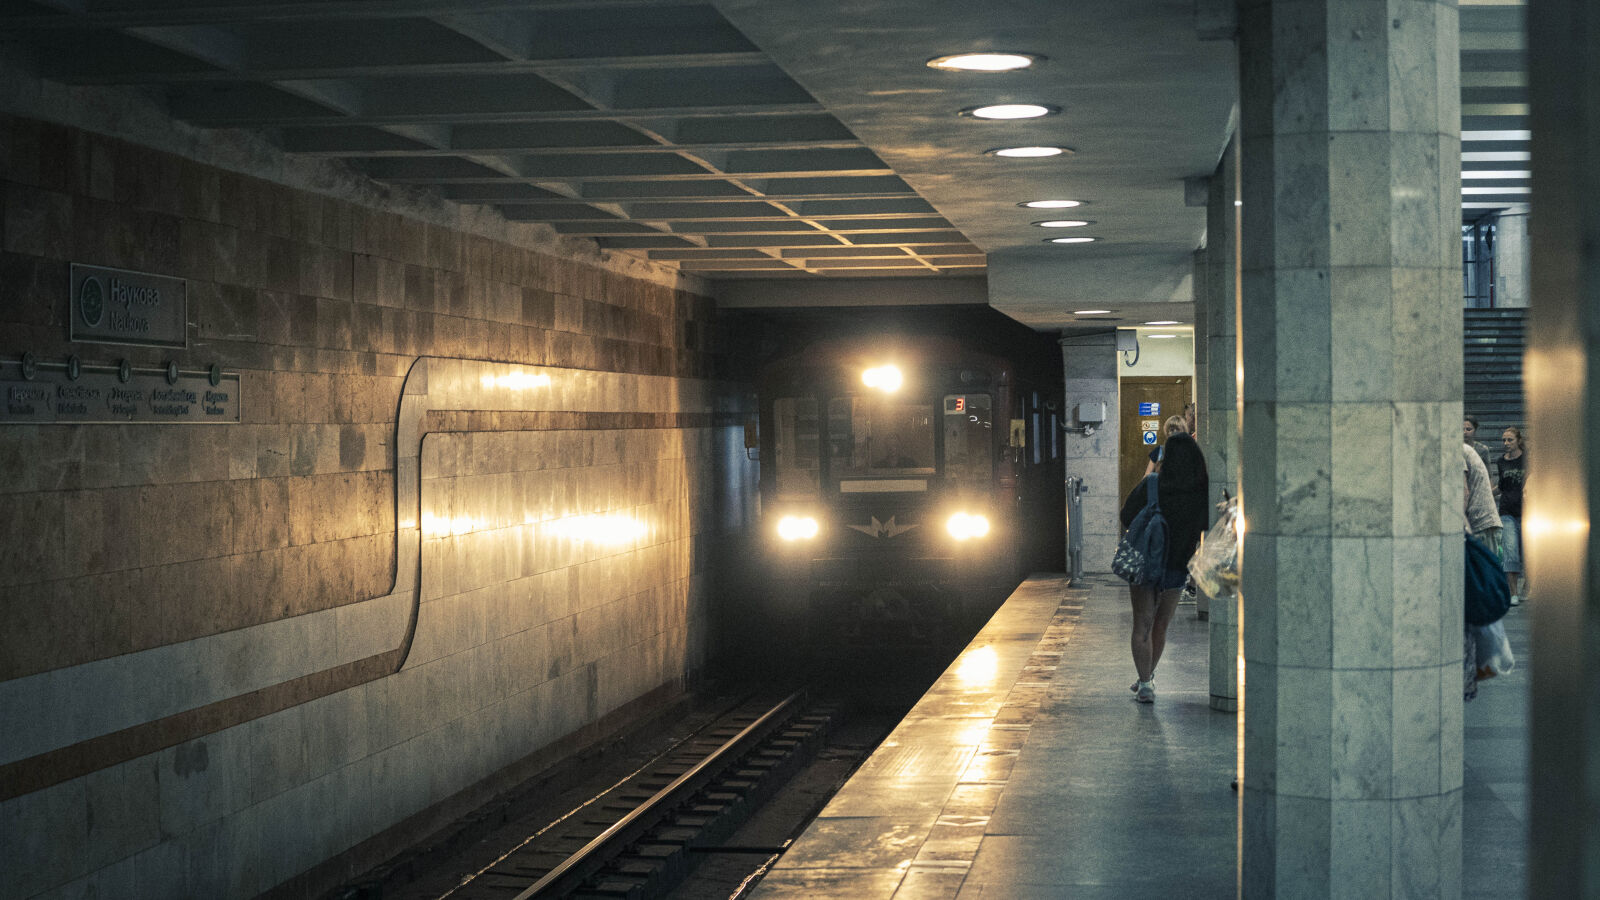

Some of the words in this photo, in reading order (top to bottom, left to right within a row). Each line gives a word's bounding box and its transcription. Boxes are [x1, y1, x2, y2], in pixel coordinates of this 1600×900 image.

[110, 278, 161, 310] Наукова
[110, 311, 152, 333] Naukova
[955, 397, 965, 411] 3
